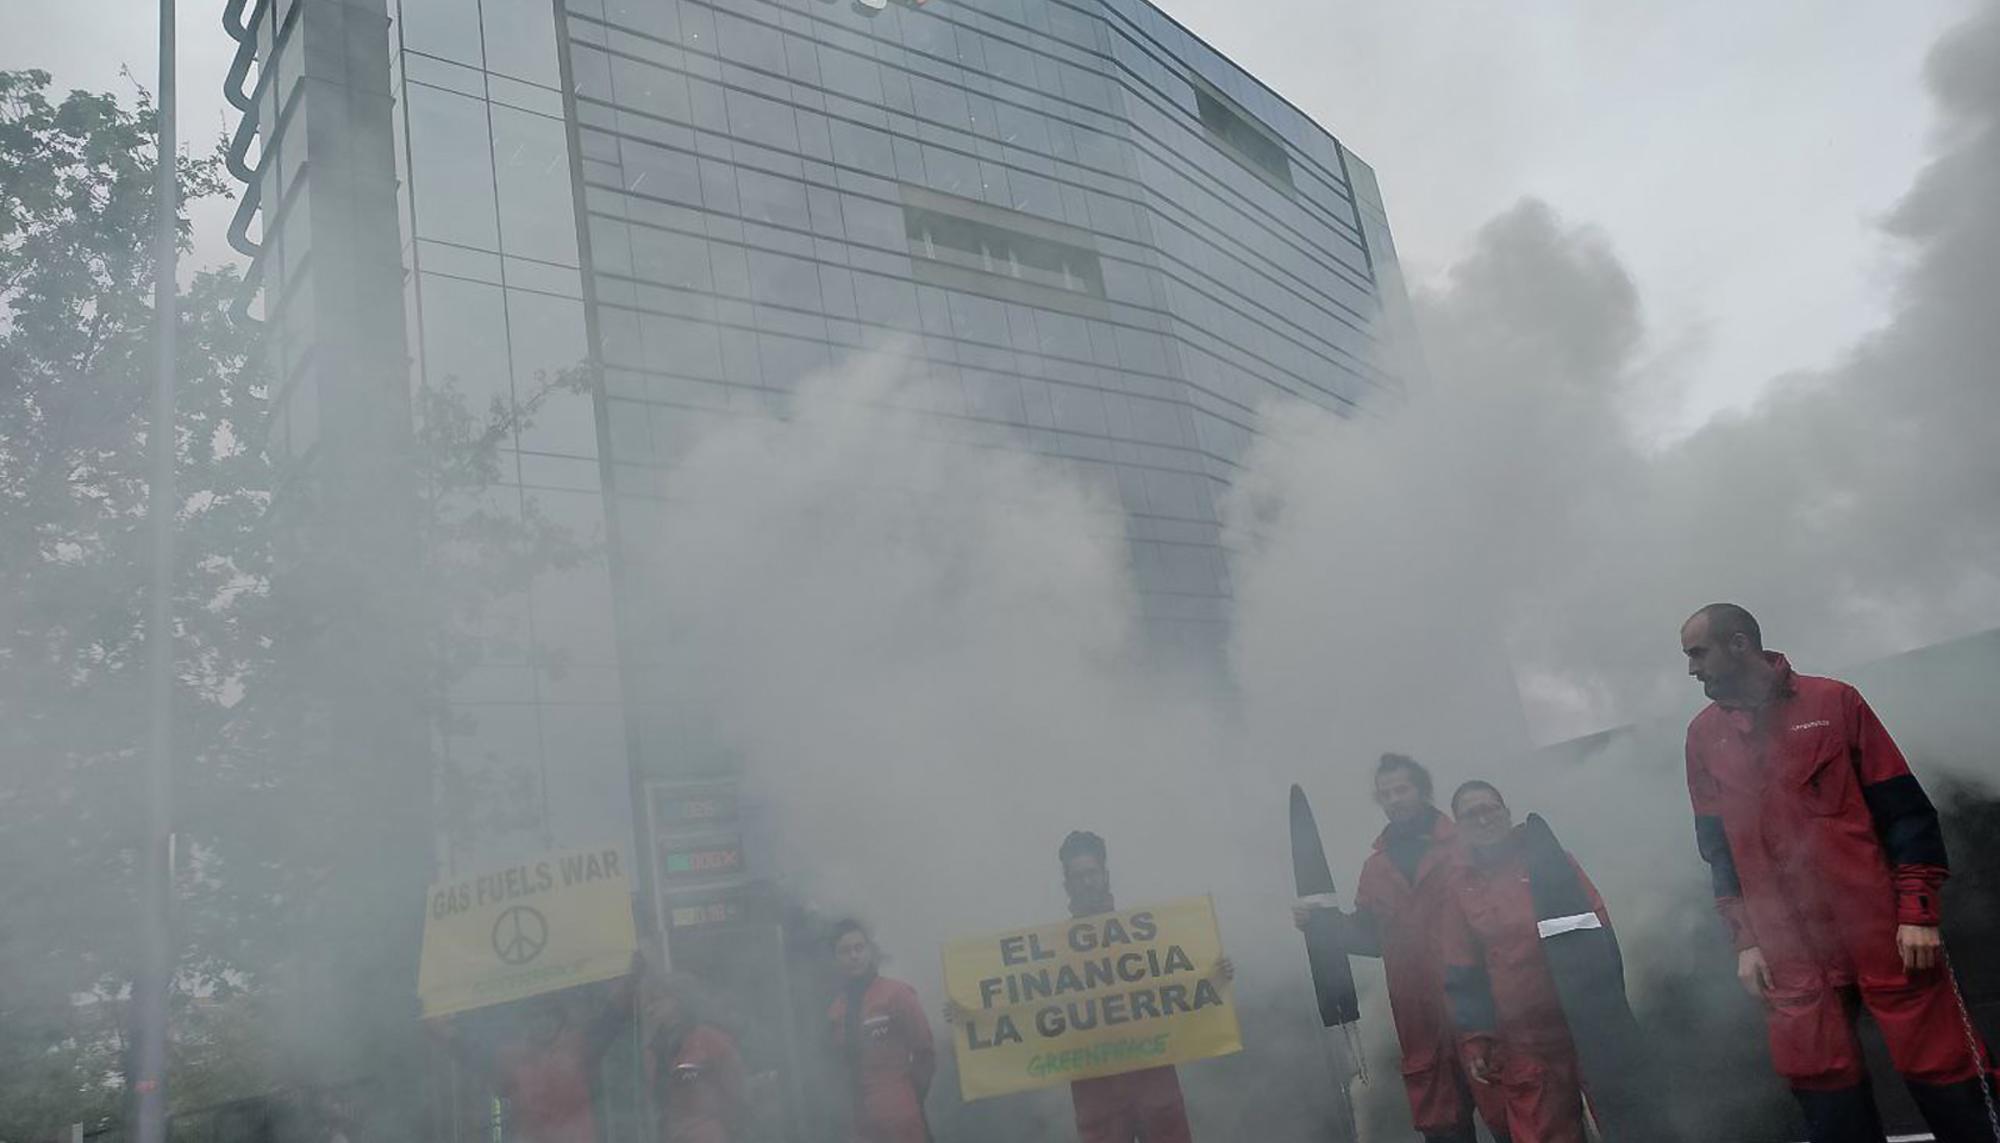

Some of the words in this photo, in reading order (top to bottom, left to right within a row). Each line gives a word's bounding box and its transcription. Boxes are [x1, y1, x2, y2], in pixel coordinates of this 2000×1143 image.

[432, 883, 471, 919] GAS
[477, 863, 553, 906] FUELS
[560, 850, 622, 887] WAR
[1000, 933, 1055, 966] EL
[1068, 912, 1157, 952] GAS
[980, 945, 1194, 1009] FINANCIA
[965, 1015, 1023, 1050] LA
[1035, 979, 1223, 1037] GUERRA
